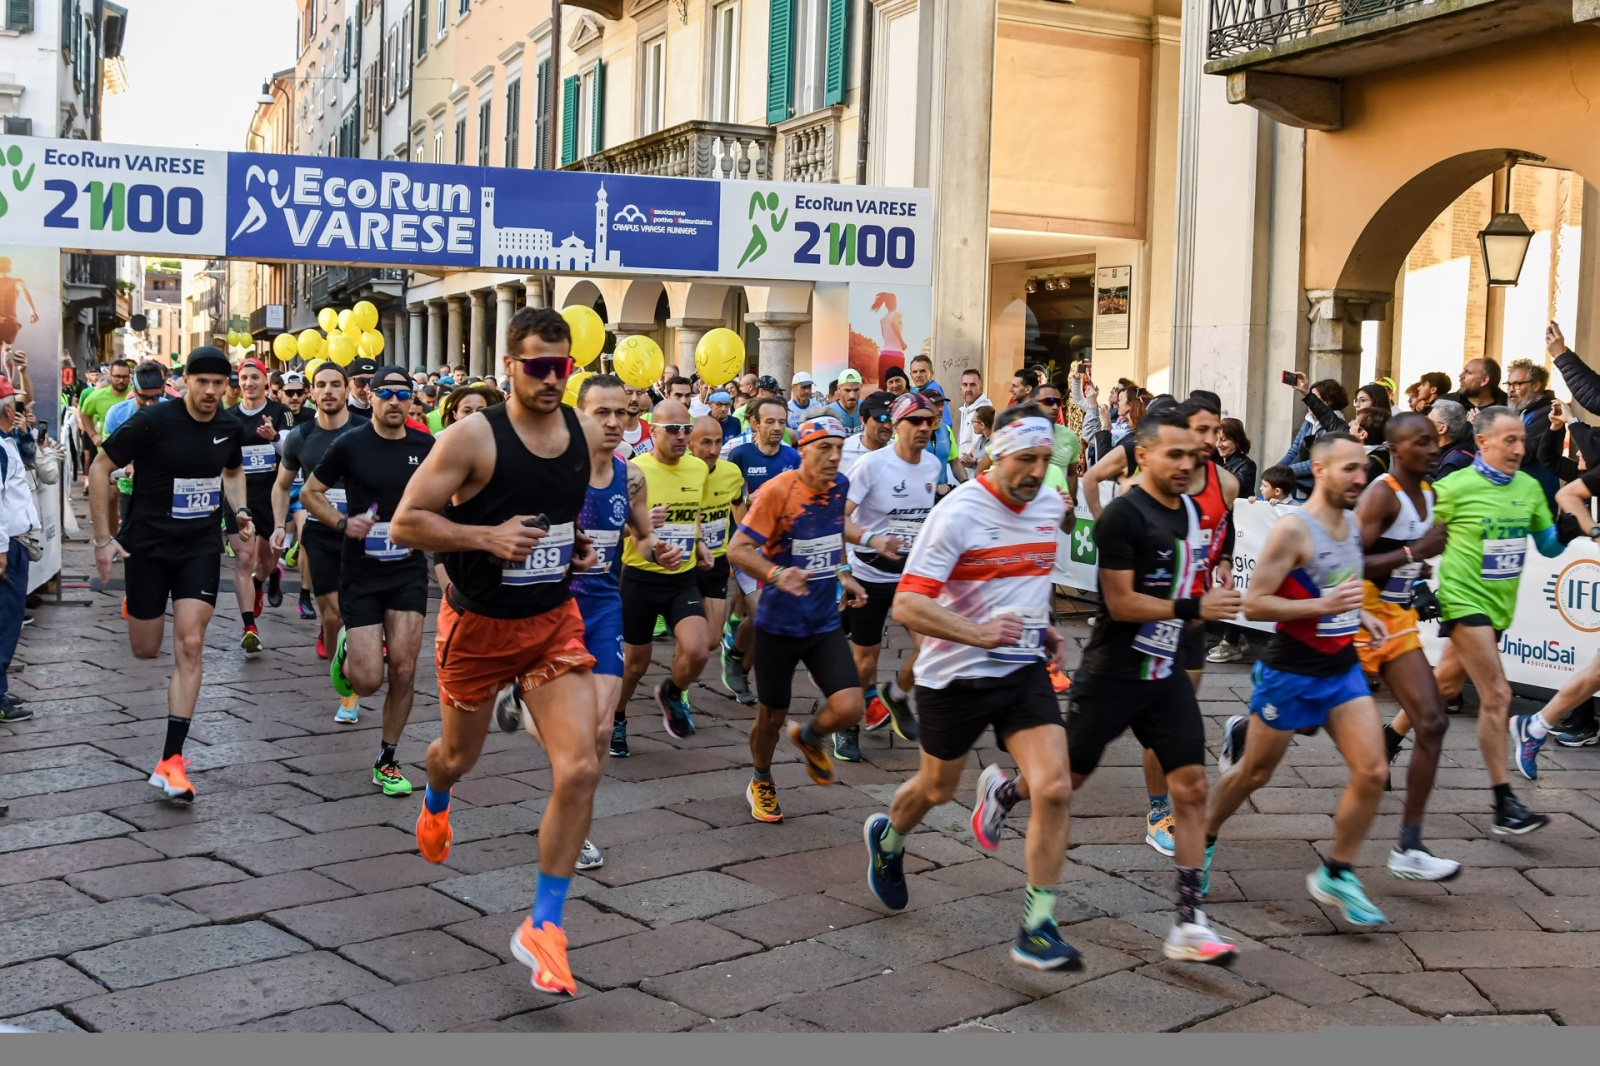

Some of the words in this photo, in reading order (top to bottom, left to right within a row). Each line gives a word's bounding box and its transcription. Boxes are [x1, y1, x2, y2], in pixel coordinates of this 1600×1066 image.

[44, 148, 121, 169] EcoRun
[124, 154, 206, 175] VARESE
[293, 166, 471, 213] EcoRun
[794, 195, 853, 212] EcoRun
[856, 199, 918, 217] VARESE
[283, 208, 475, 254] VARESE
[612, 223, 640, 233] CAMPUS
[640, 225, 666, 234] VARESE
[666, 226, 698, 236] RUNNERS
[250, 455, 266, 467] 95
[186, 492, 211, 509] 120
[525, 547, 562, 570] 189
[805, 552, 833, 570] 251
[1497, 634, 1576, 665] UnipolSai
[1526, 660, 1575, 673] ASSICURAZIONI
